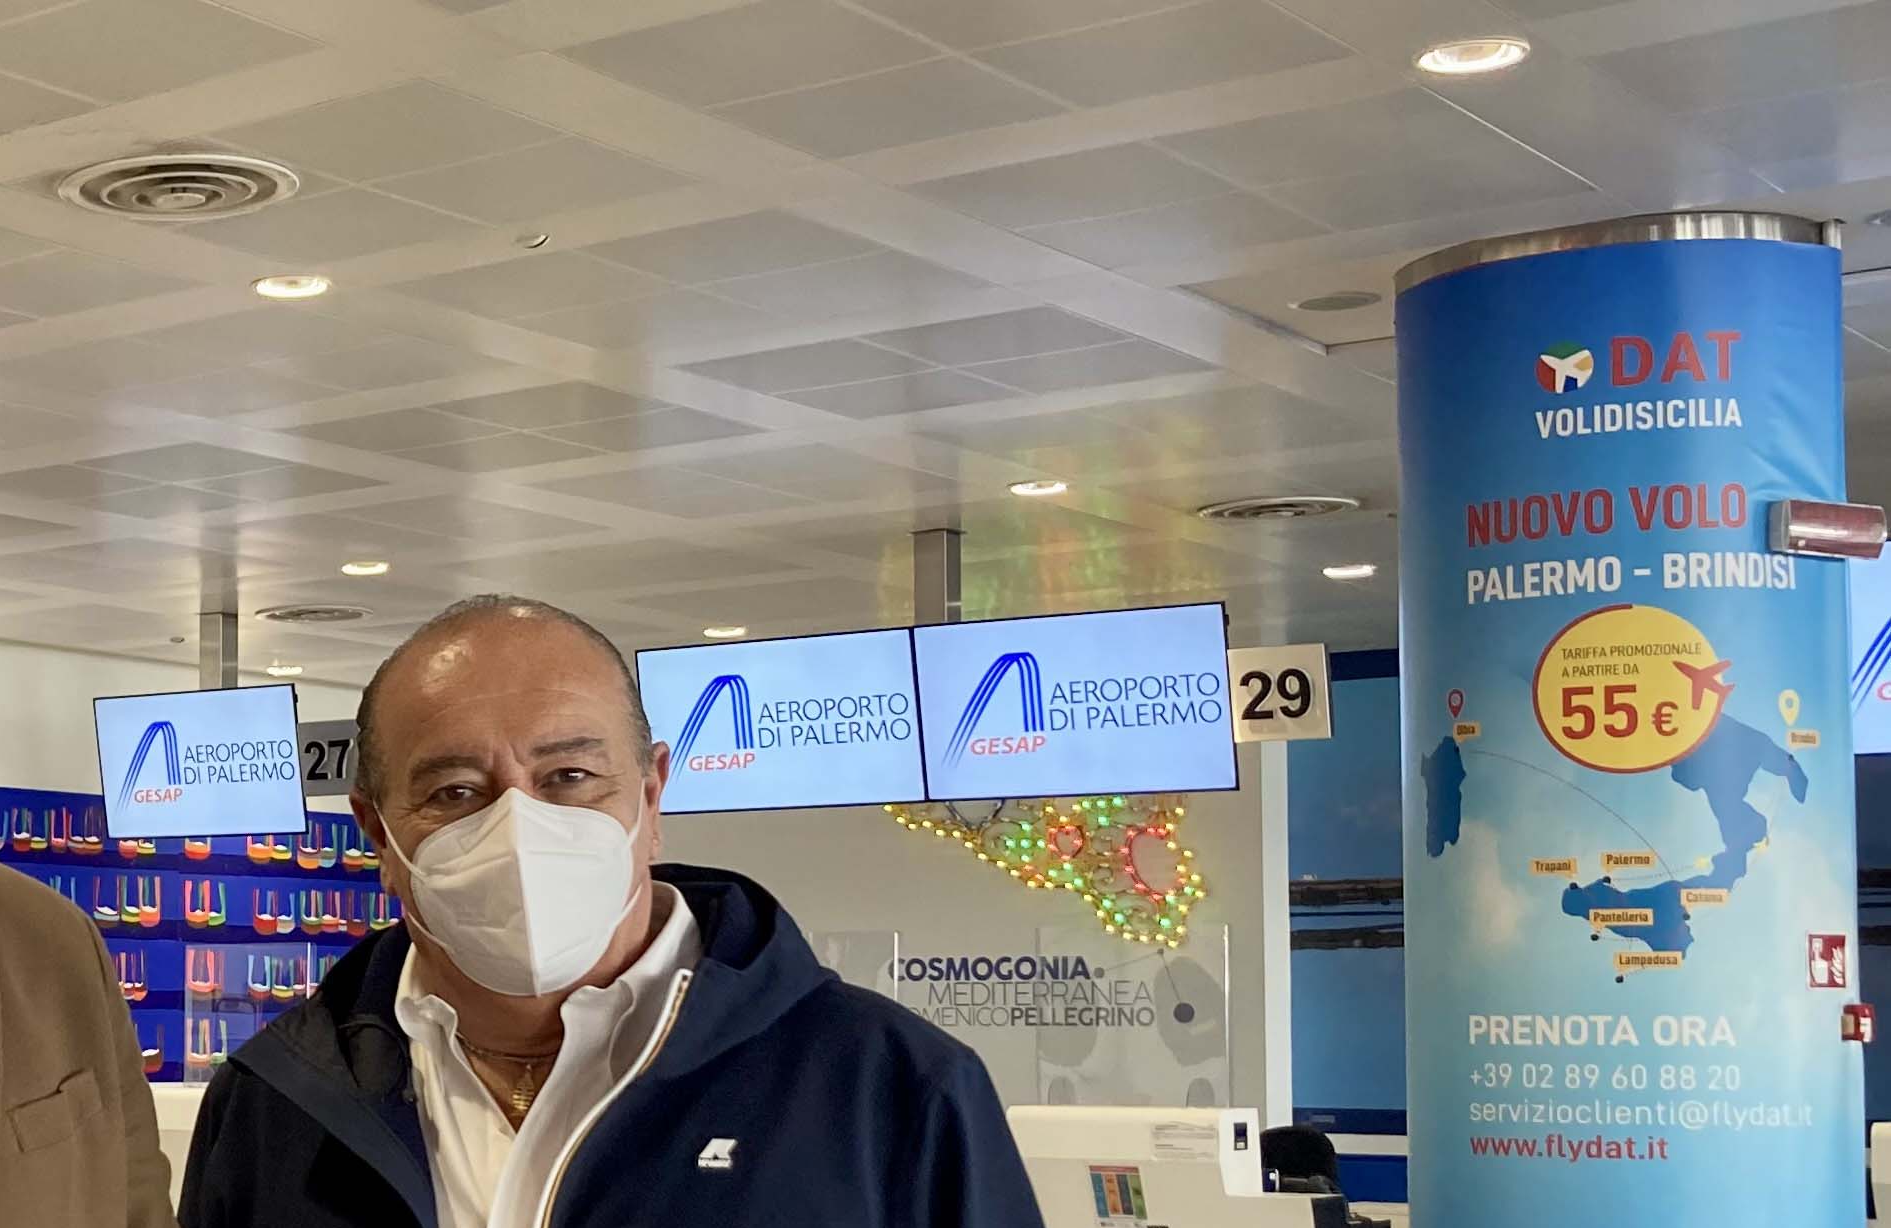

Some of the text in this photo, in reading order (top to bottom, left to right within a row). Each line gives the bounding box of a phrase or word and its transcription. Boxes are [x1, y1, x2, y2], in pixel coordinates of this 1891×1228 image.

[1611, 331, 1742, 388] DAT
[1535, 398, 1742, 439] VOLIDISICILIA
[1467, 483, 1747, 548] NUOVO VOLO
[1467, 555, 1622, 605] PALERMO
[1663, 551, 1796, 590] BRINDISI
[1561, 642, 1702, 661] TARIFFA PROMOZIONALE
[1562, 663, 1639, 678] A PARTIRE DA
[1050, 672, 1220, 705] AEROPORTO
[1239, 668, 1313, 721] 29
[759, 693, 909, 725] AEROPORTO
[1049, 700, 1222, 731] DI PALERMO
[1561, 684, 1679, 740] 55 €
[758, 718, 911, 748] DI PALERMO
[970, 735, 1046, 756] GESAP
[184, 740, 293, 764] AEROPORTO
[304, 739, 354, 781] 27
[689, 752, 756, 772] GESAP
[184, 761, 295, 785] DI PALERMO
[134, 788, 183, 803] GESAP
[1534, 861, 1571, 873] Trapani
[1605, 853, 1650, 866] Palermo
[1592, 911, 1649, 924] Pantelleria
[888, 956, 1091, 982] COSMOGONIA
[1618, 953, 1678, 967] Lampedusa
[928, 980, 1154, 1006] MEDITERRANEA
[1469, 1015, 1737, 1048] PRENOTA ORA
[1470, 1063, 1742, 1090] +39 02 89 60 88 20
[1469, 1134, 1669, 1162] www.flydat.it
